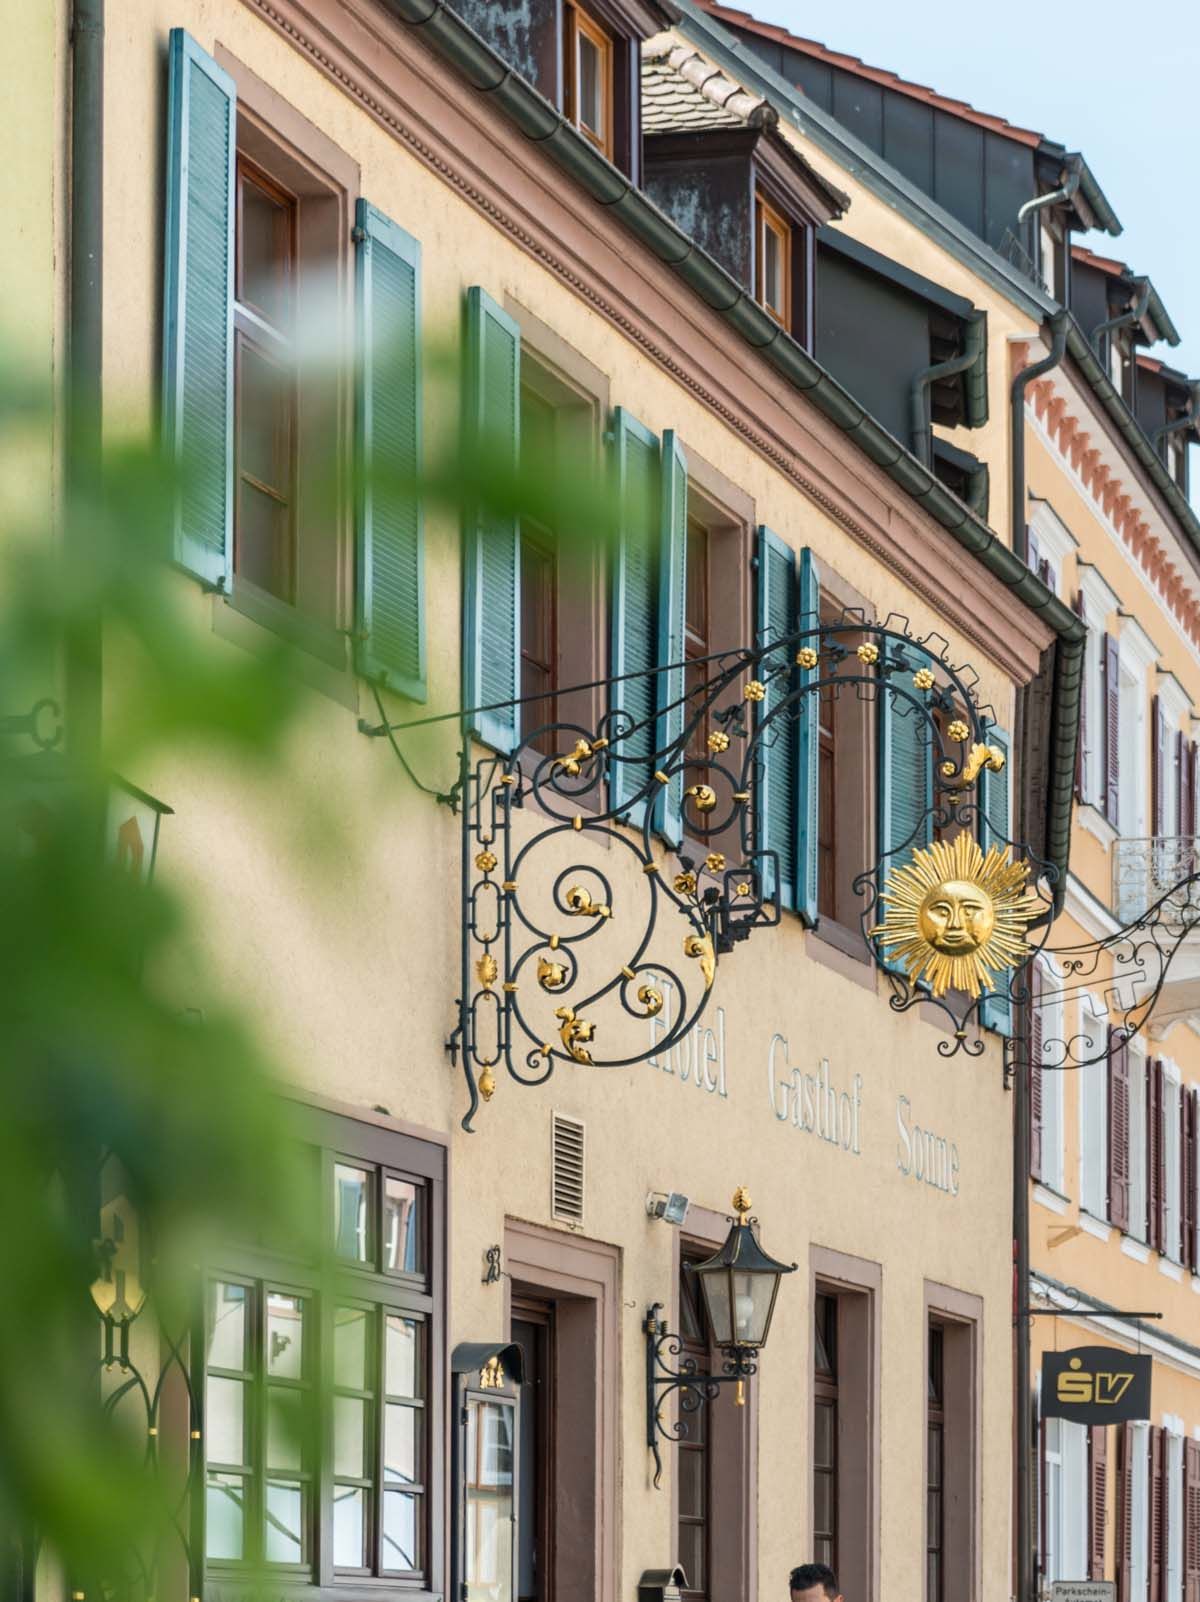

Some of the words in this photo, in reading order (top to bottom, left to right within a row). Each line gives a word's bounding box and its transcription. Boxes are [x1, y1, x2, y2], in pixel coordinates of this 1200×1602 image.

[646, 971, 728, 1099] Hotel
[768, 1033, 864, 1155] Gasthof
[896, 1094, 960, 1197] Sonne
[1055, 1586, 1111, 1597] Parkschein-
